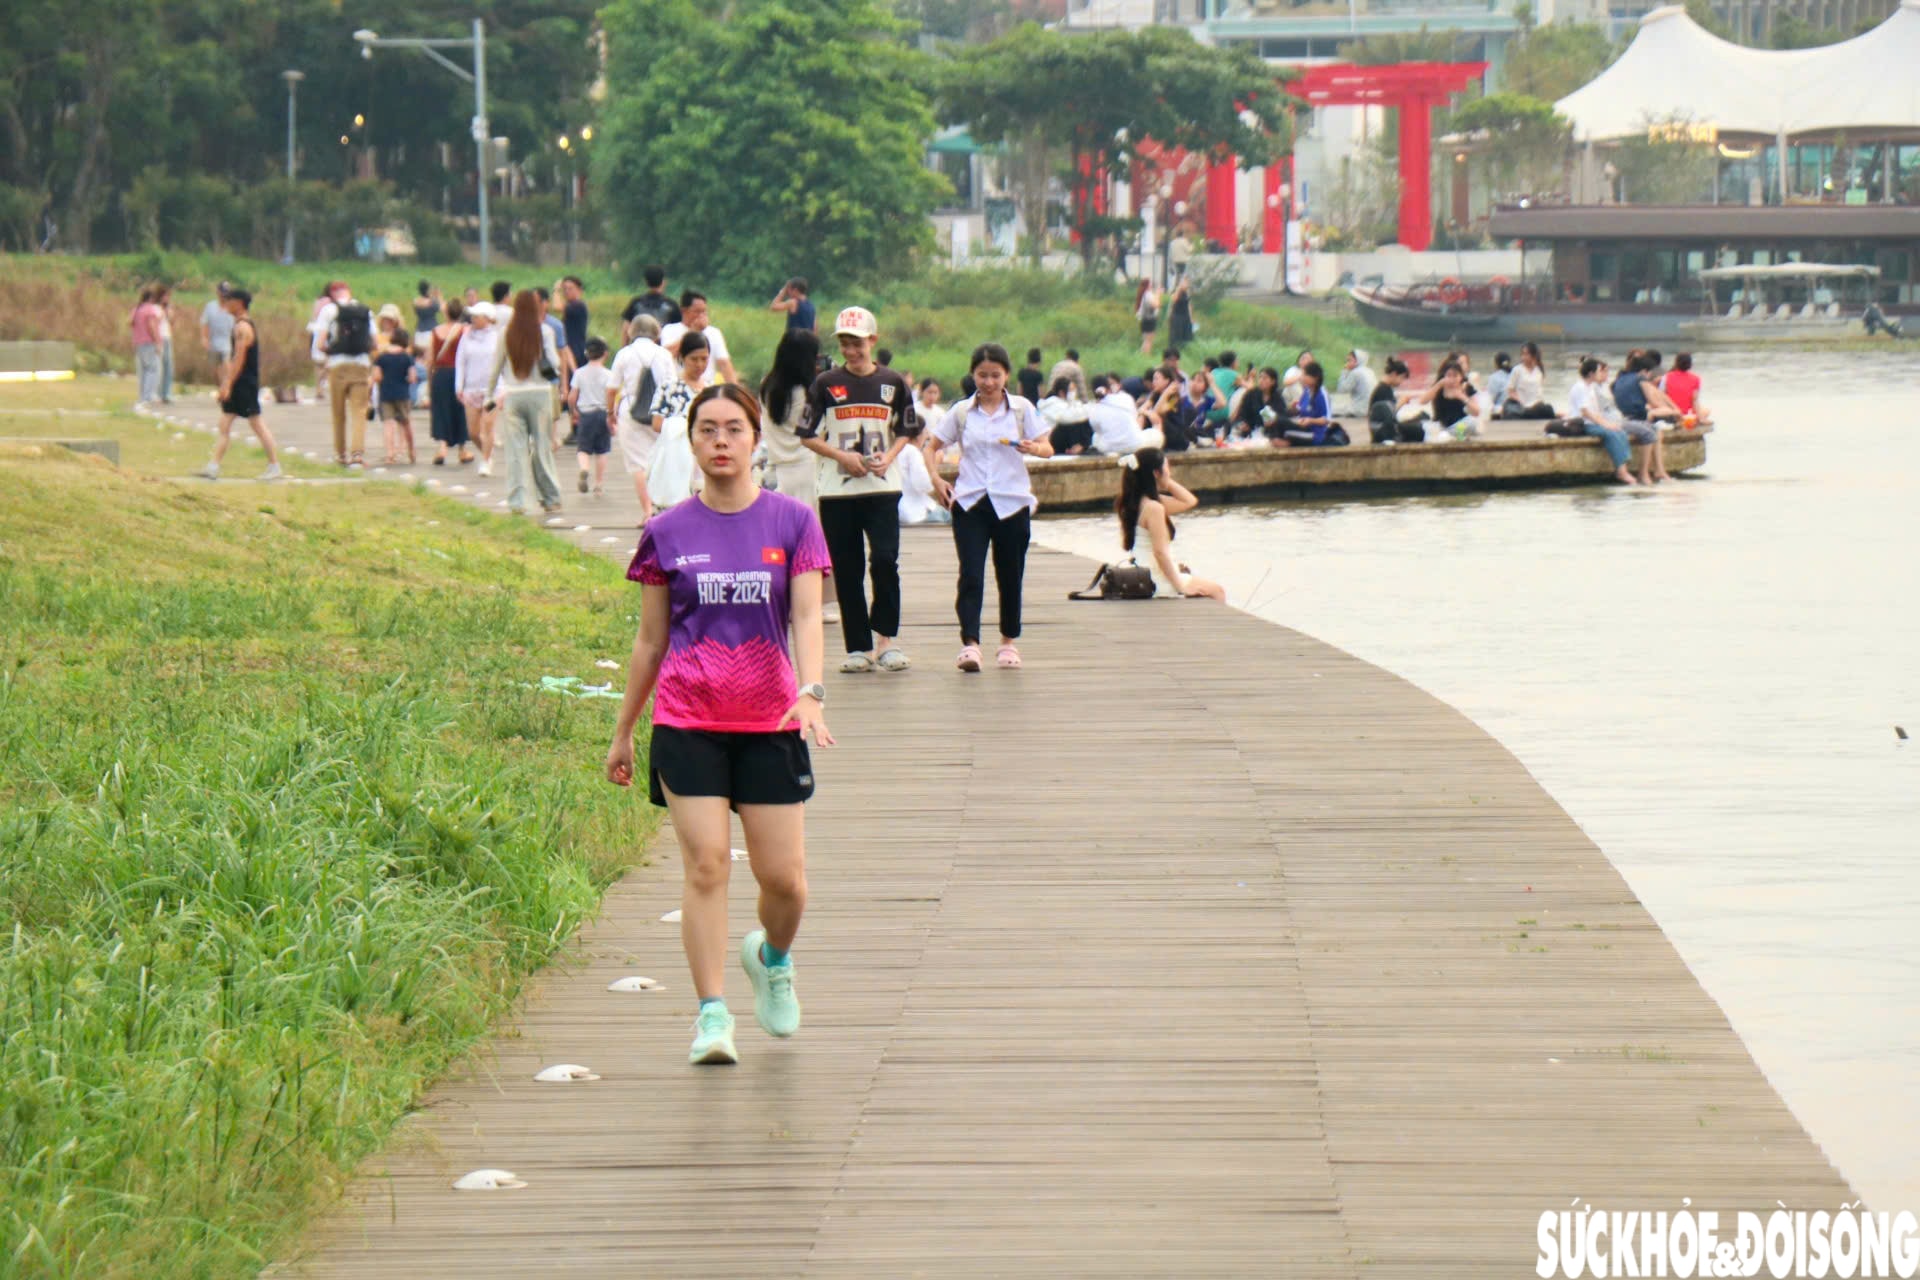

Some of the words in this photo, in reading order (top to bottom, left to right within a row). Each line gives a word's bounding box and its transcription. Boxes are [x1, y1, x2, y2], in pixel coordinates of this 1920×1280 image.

[696, 572, 734, 583] VNEXPRESS
[736, 571, 771, 582] MARATHON
[698, 582, 728, 604] HUE
[732, 581, 770, 604] 2024
